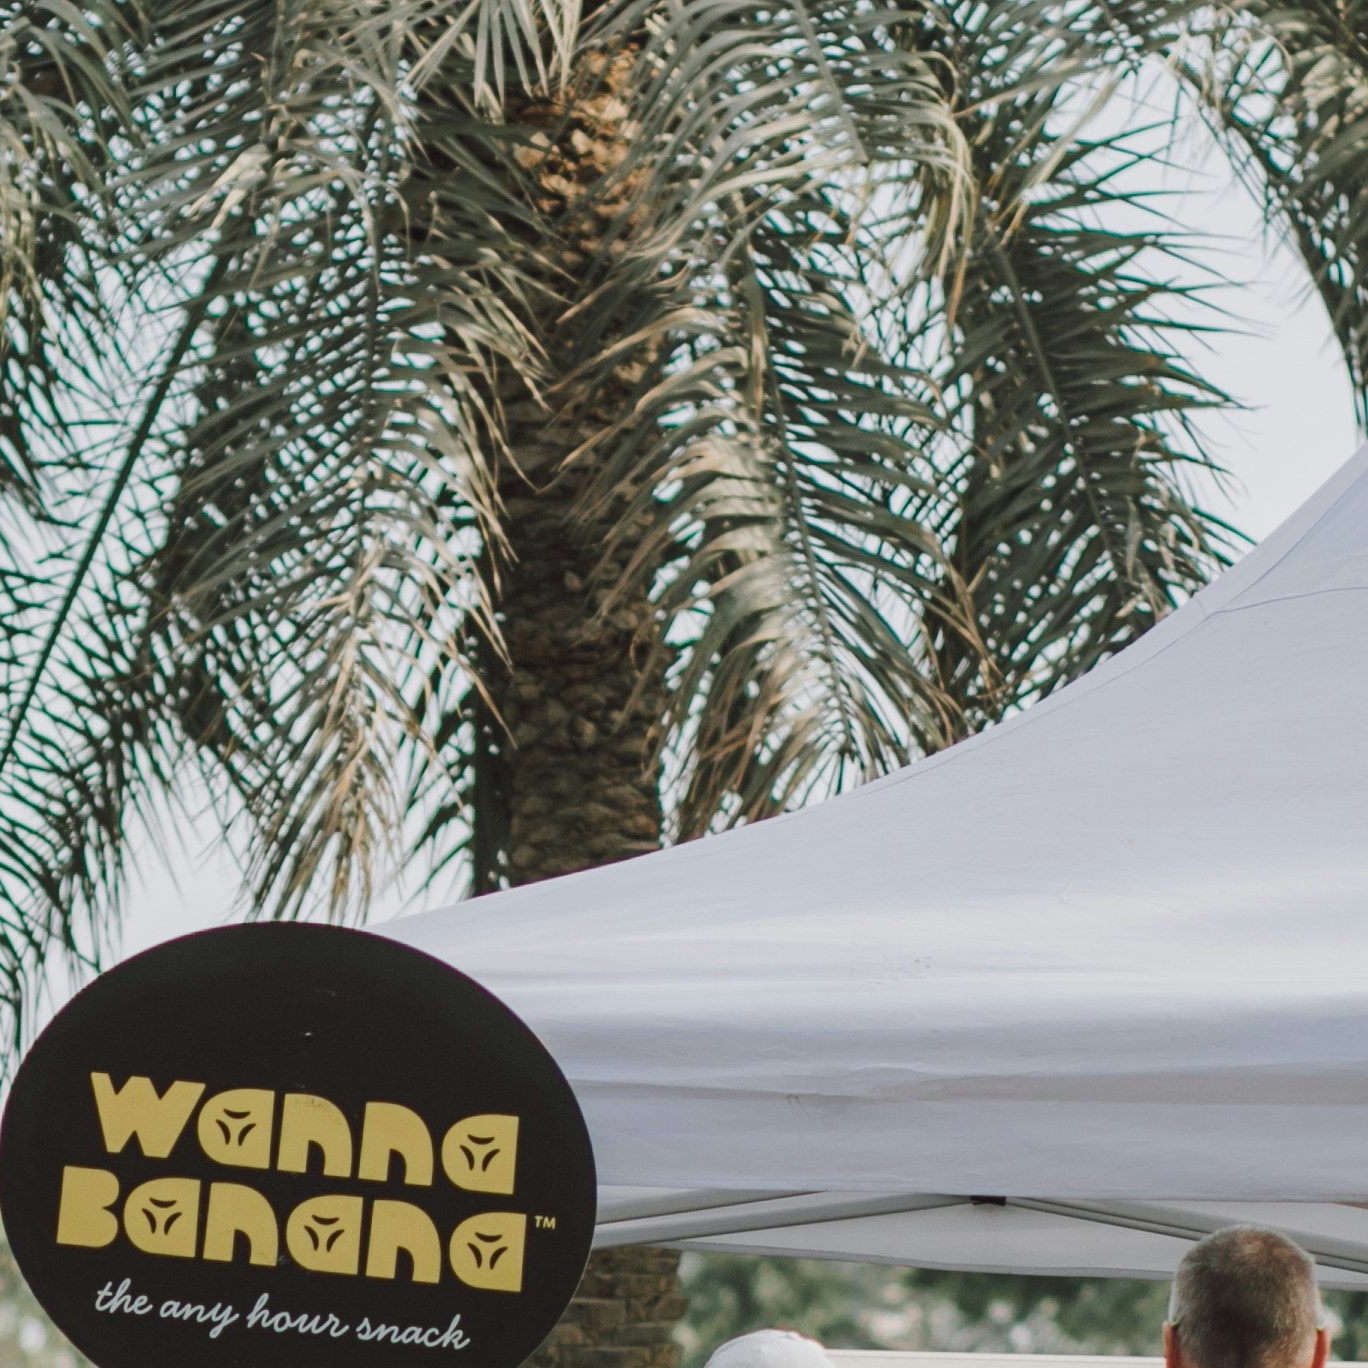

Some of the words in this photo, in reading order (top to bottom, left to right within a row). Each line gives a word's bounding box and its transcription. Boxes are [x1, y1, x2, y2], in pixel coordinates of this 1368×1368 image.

[95, 1278, 153, 1314] the
[159, 1296, 239, 1339] any
[246, 1293, 349, 1338] hour
[355, 1313, 471, 1350] snack
